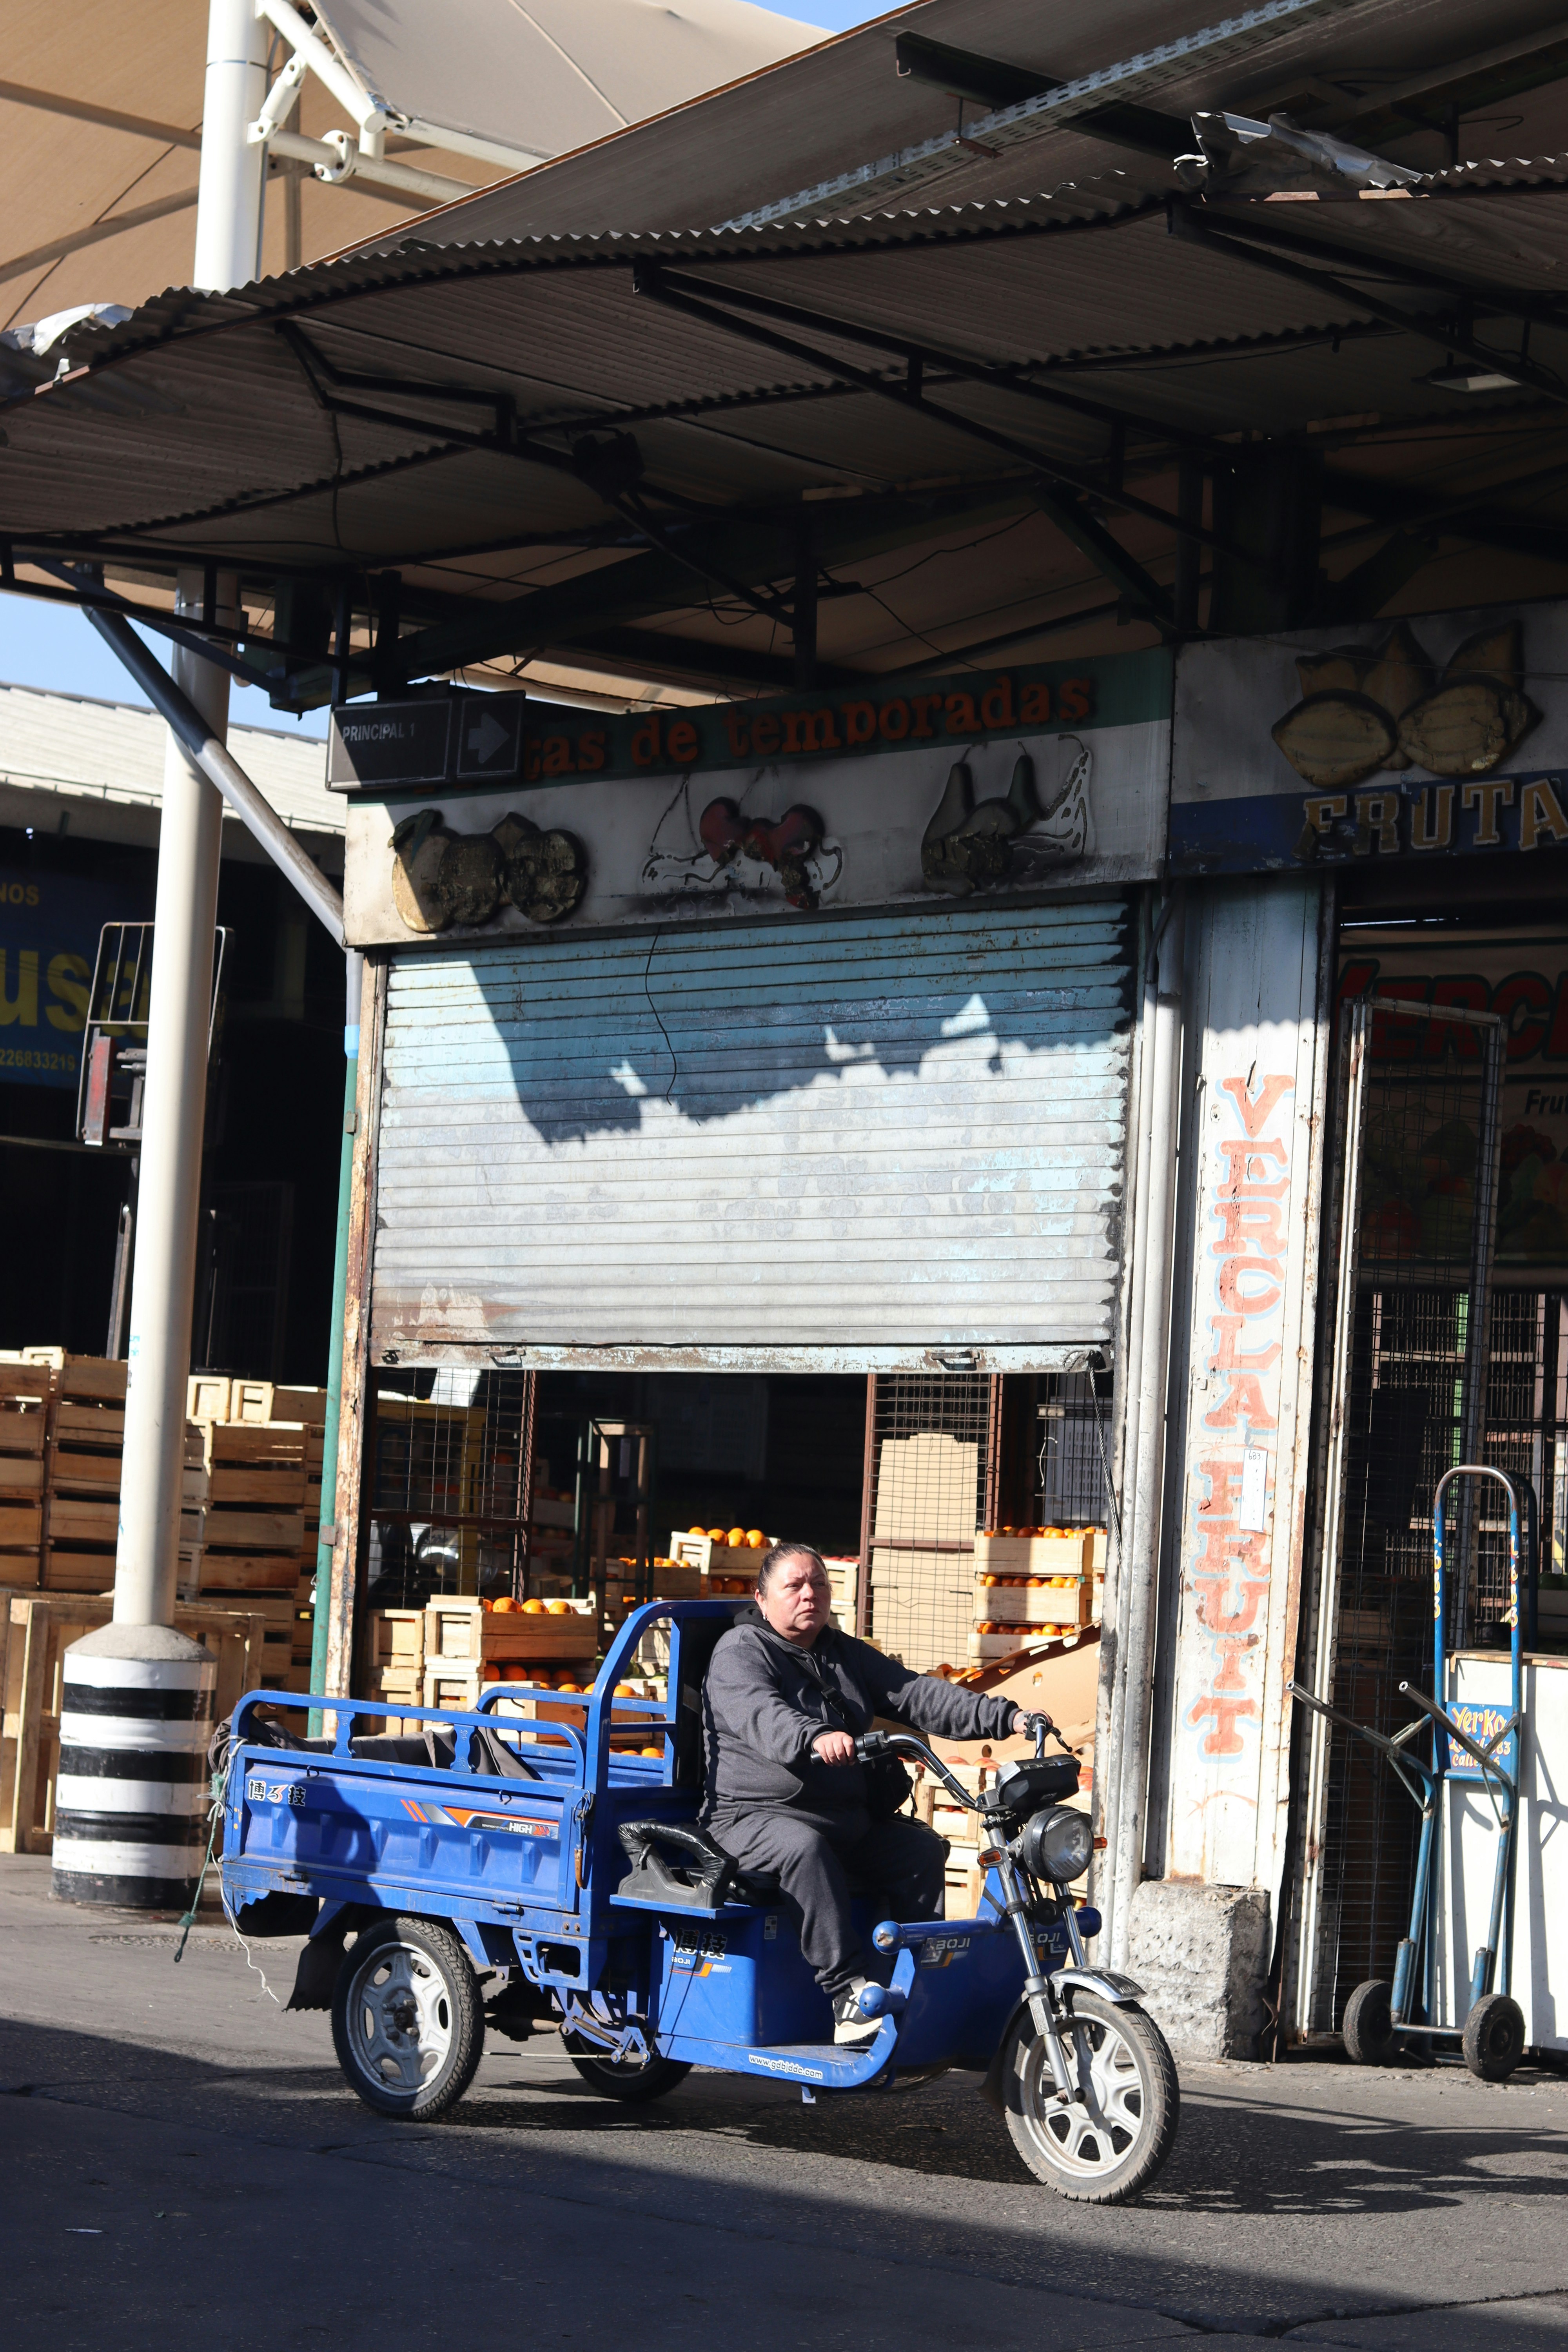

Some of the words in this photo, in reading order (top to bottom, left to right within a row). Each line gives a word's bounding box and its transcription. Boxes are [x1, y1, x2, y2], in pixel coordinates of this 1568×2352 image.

[632, 715, 699, 767] de
[722, 675, 1091, 758] temporadas
[342, 722, 405, 742] PRINCIPAL
[410, 722, 415, 737] 1
[1248, 1449, 1261, 1461] 683
[509, 1822, 533, 1835] HIGH
[935, 1937, 971, 1951] BOJI
